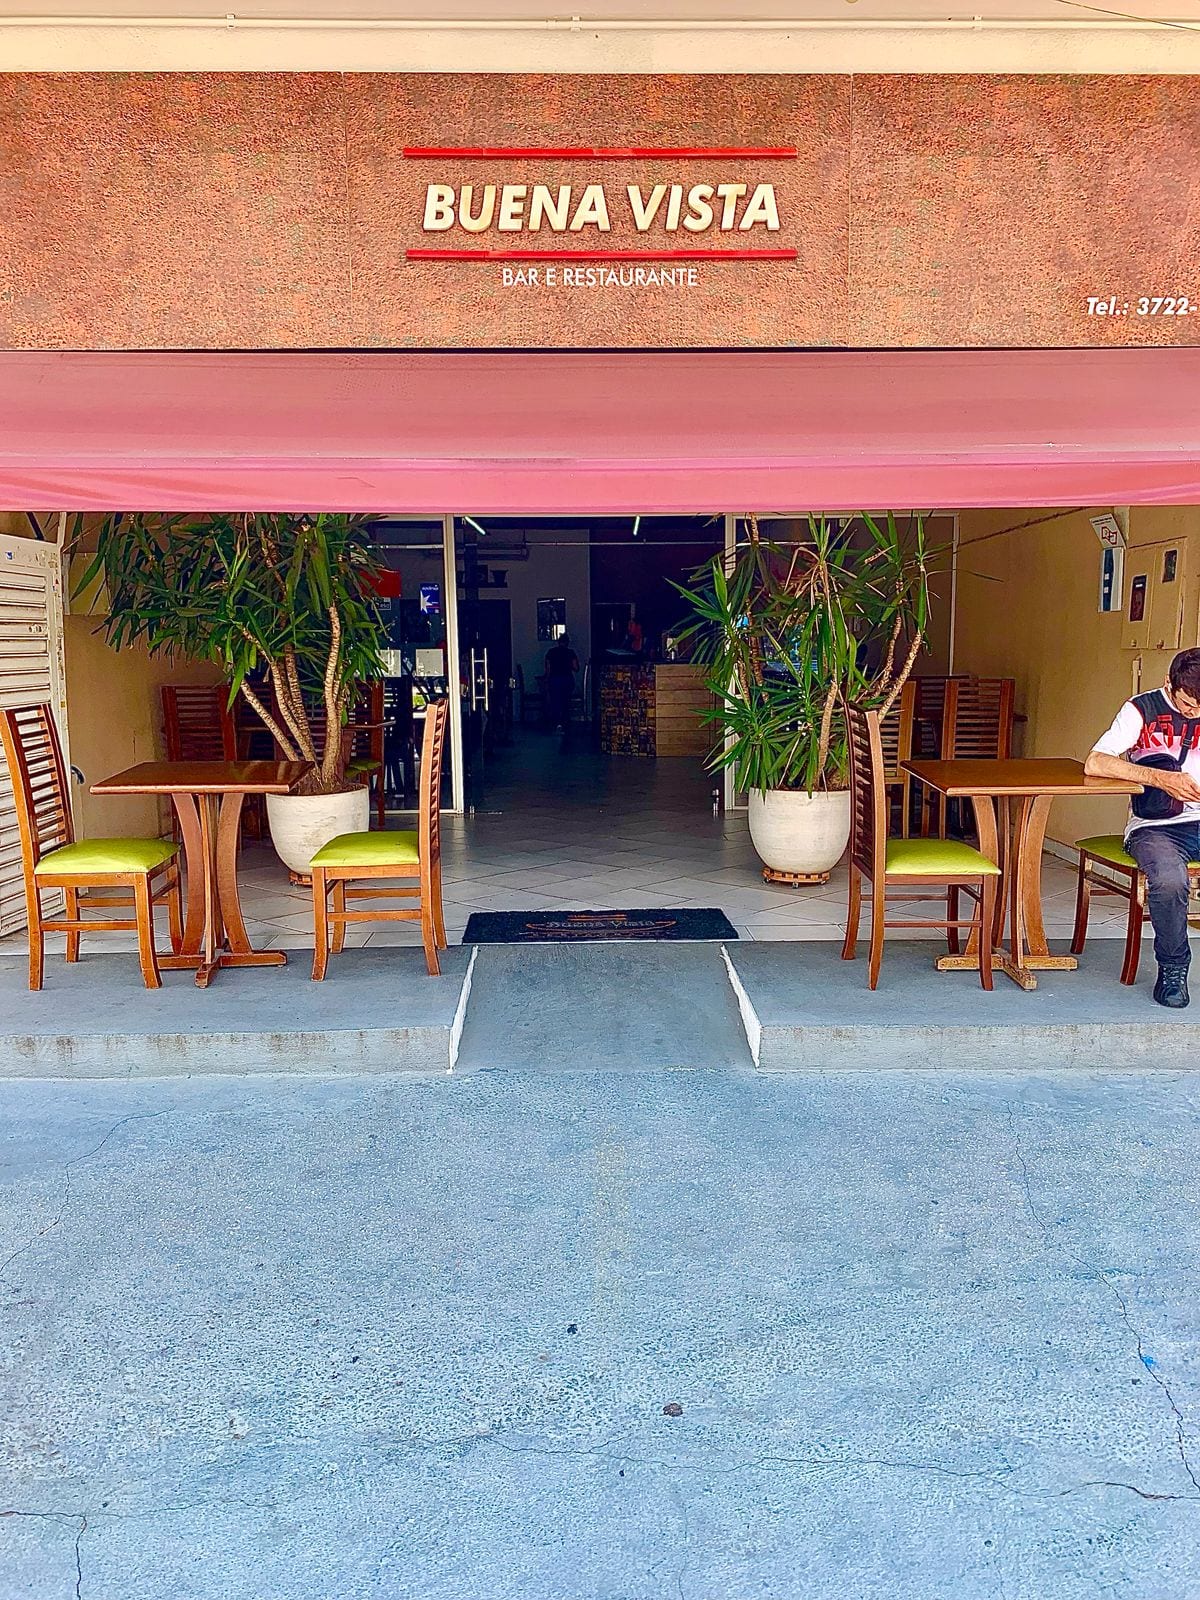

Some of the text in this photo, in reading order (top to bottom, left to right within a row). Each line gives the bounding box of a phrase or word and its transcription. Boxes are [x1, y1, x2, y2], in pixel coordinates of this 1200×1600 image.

[422, 184, 782, 233] BUENA VISTA
[502, 268, 698, 287] BAR E RESTAURANTE
[1086, 296, 1198, 316] Tel.: 3722-
